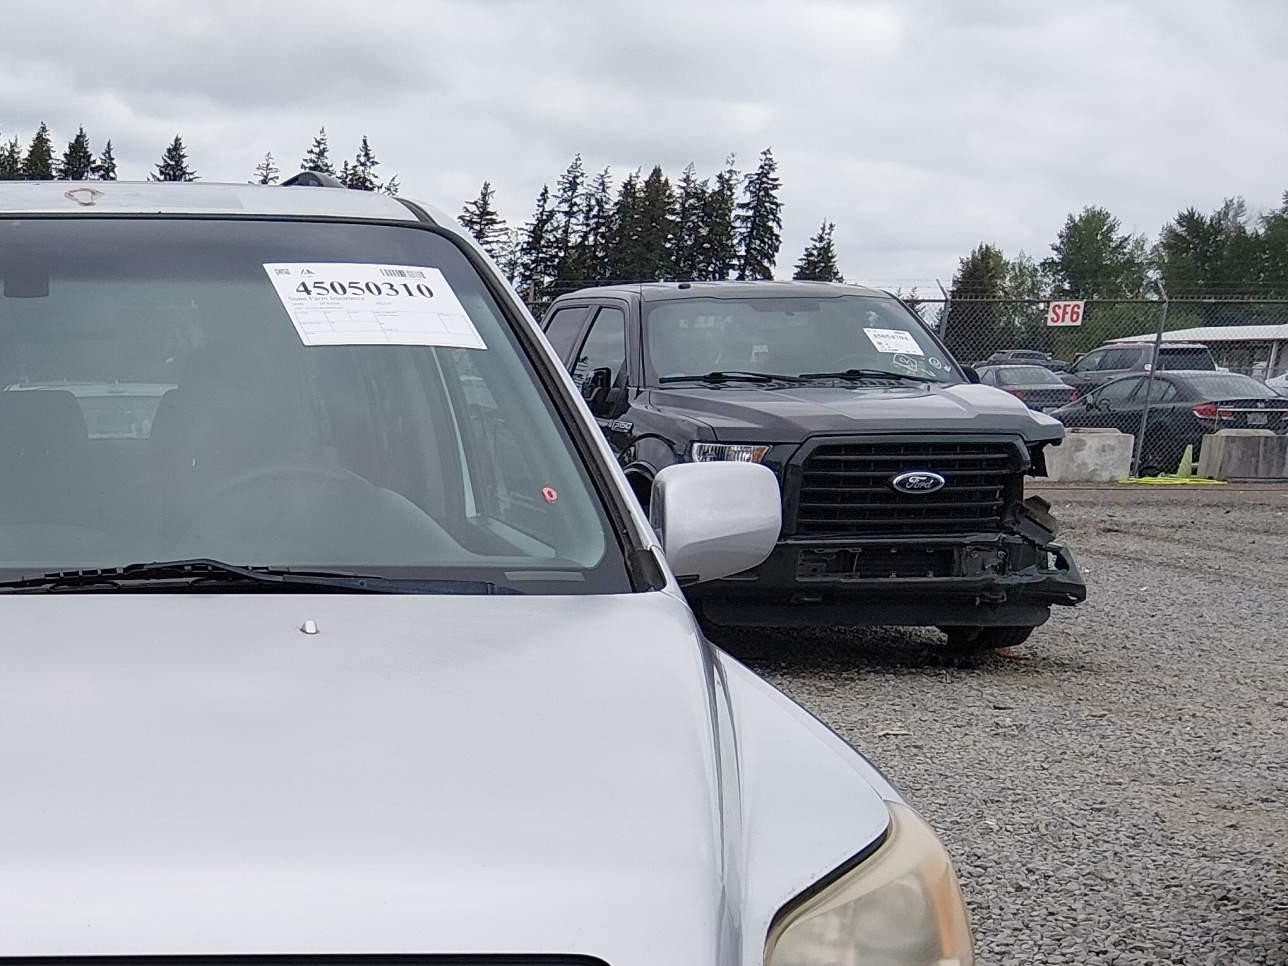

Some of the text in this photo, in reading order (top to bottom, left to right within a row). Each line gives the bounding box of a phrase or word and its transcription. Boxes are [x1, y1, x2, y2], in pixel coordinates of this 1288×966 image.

[296, 280, 434, 299] 45050310
[1050, 304, 1081, 323] SF6
[905, 476, 934, 489] Ford
